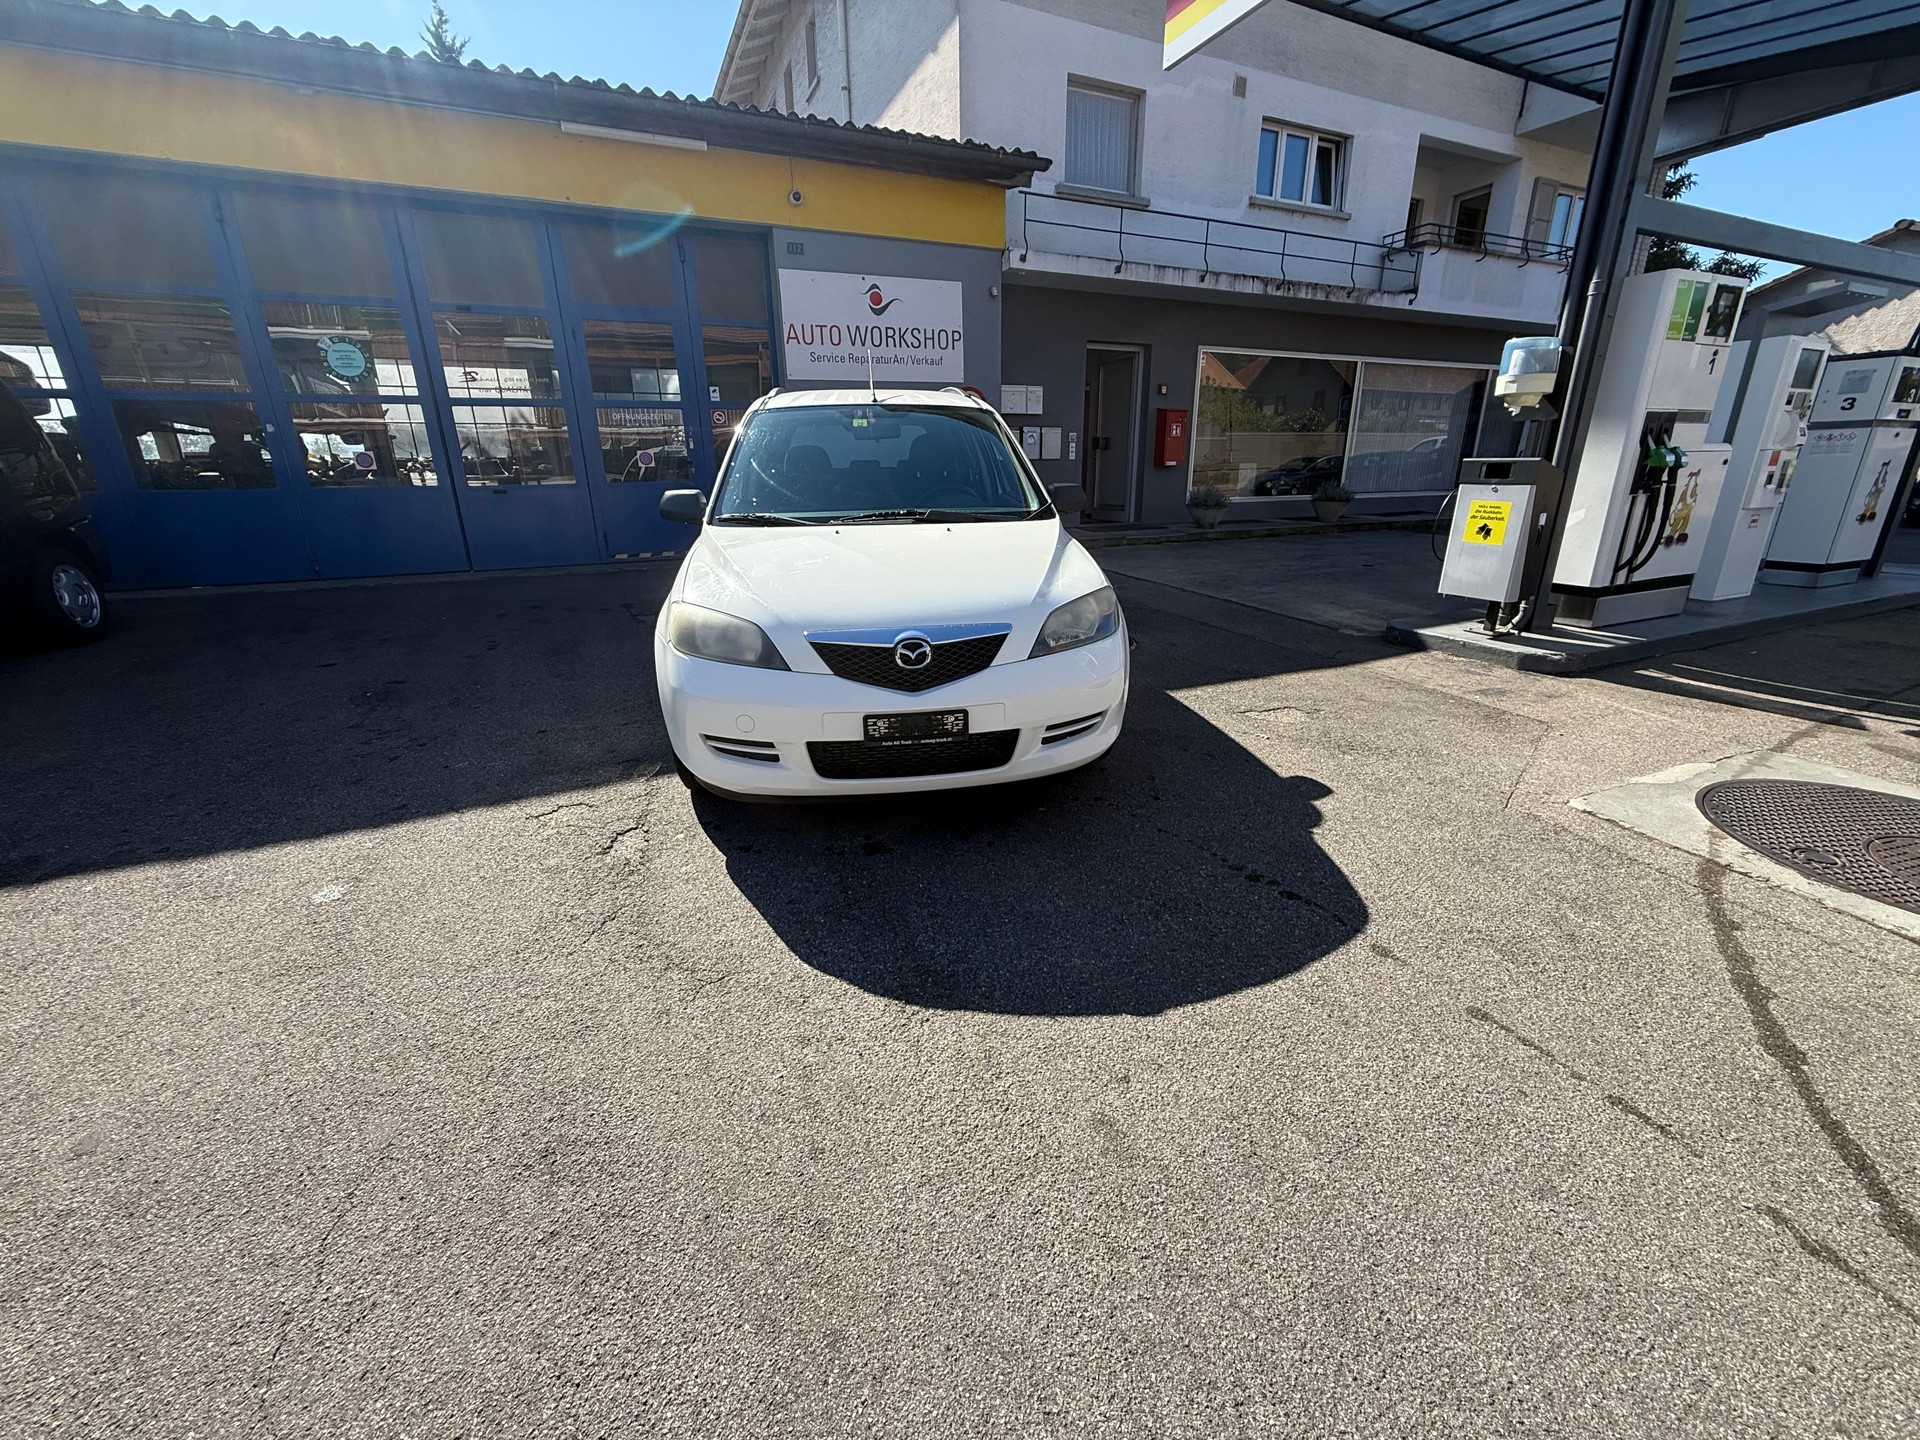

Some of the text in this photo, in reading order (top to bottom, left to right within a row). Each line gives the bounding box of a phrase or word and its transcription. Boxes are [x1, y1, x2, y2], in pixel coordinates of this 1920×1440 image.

[789, 243, 802, 253] 112
[786, 323, 962, 351] AUTO WORKSHOP
[809, 351, 846, 364] Service
[1708, 357, 1717, 375] 1
[1840, 397, 1857, 411] 3
[612, 411, 674, 420] ÖFFNUNGSZEITEN
